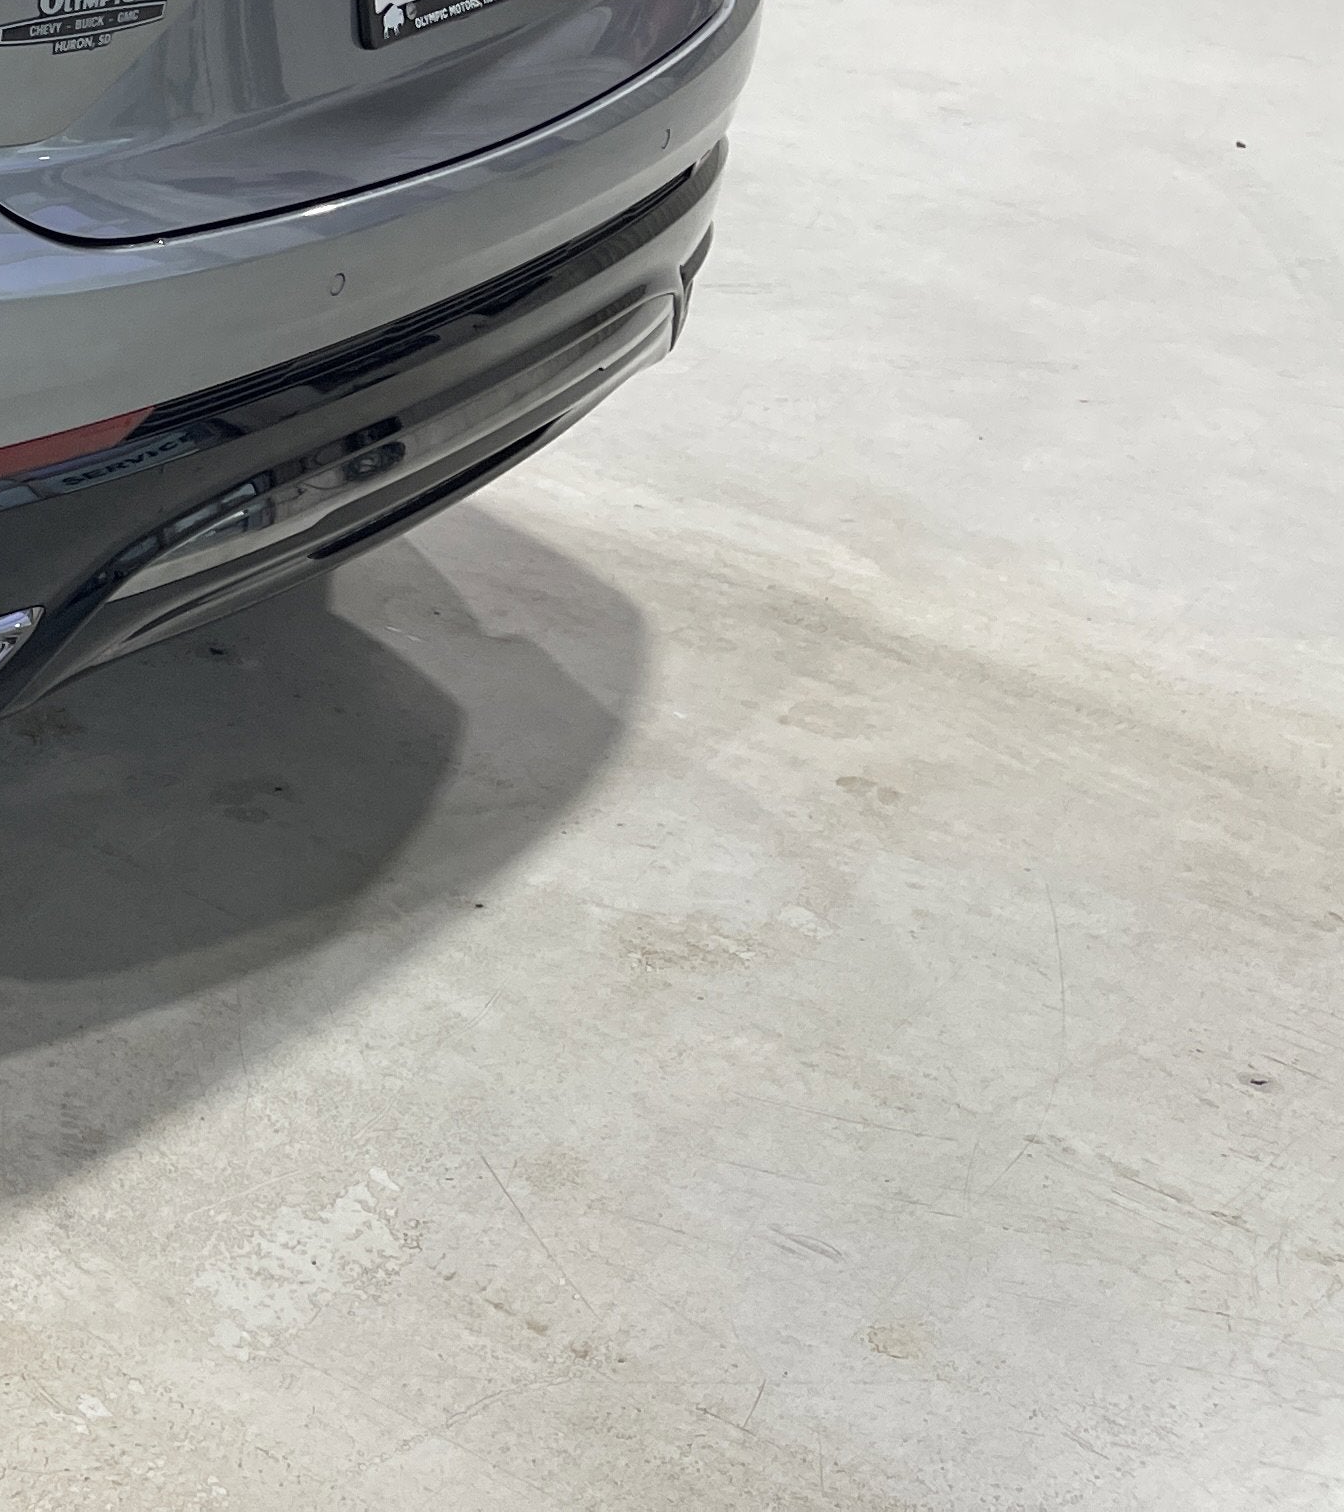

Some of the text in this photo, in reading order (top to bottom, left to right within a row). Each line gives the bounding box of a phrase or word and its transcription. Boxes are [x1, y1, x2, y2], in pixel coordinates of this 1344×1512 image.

[29, 21, 62, 37] CHEVY
[75, 15, 105, 30] BUICK
[414, 7, 449, 29] OLYMPIC
[54, 36, 96, 54] HURON,
